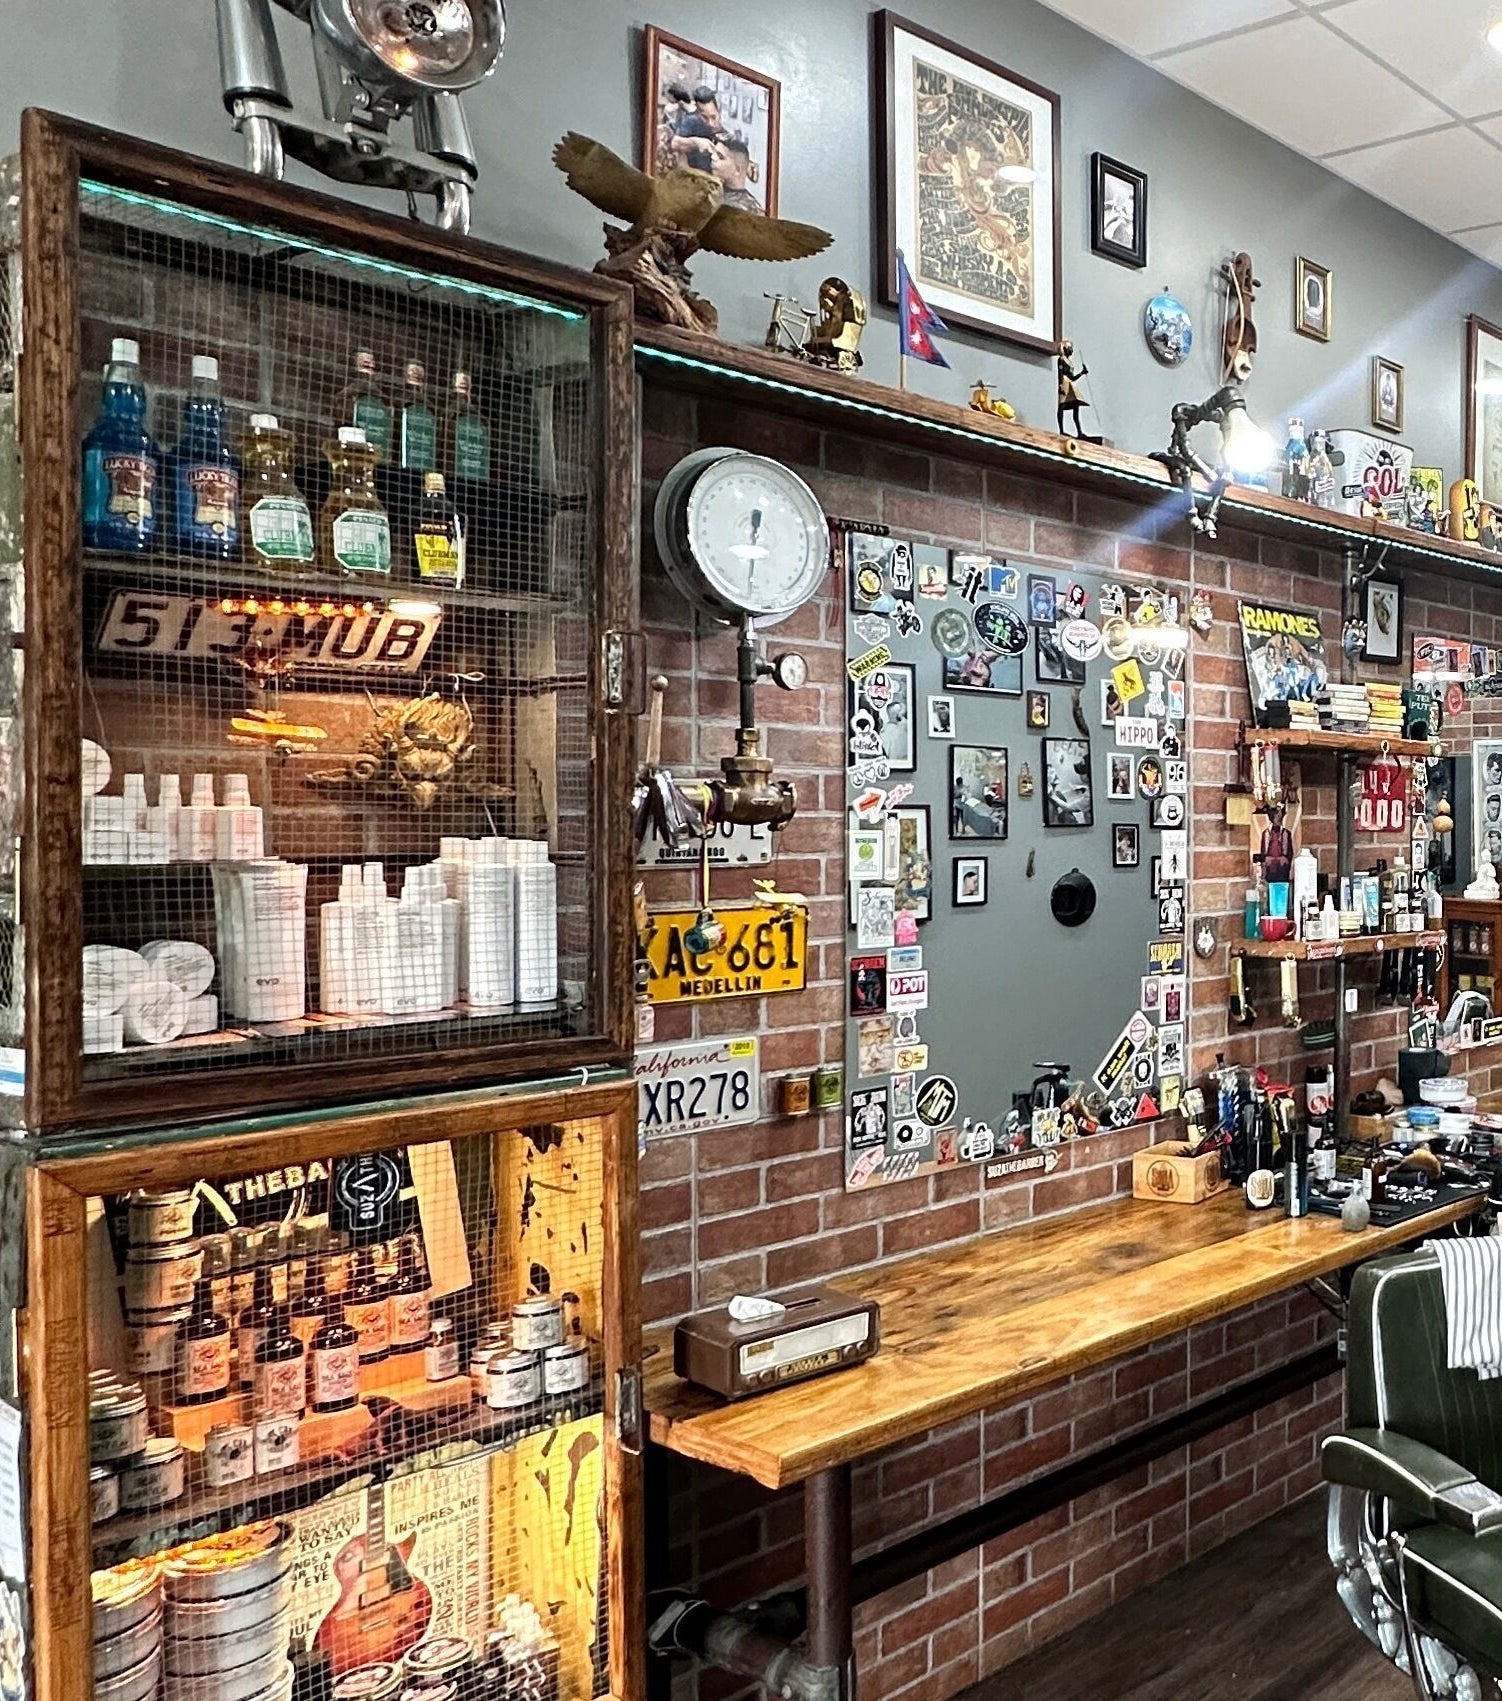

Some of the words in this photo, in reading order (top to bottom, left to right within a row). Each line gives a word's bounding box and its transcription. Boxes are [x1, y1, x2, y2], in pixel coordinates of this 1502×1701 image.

[917, 62, 948, 95] THE
[1243, 606, 1321, 639] RAMONES
[1120, 726, 1154, 745] HIPPO
[728, 921, 798, 973] 681
[256, 976, 280, 986] evo
[680, 980, 762, 997] MEDELLIN
[644, 1070, 750, 1126] XR278
[394, 1506, 454, 1535] INSPIRES
[460, 1496, 480, 1511] ME
[300, 1538, 319, 1552] TO
[325, 1528, 352, 1545] SAY
[293, 1554, 320, 1571] NGS
[323, 1551, 332, 1560] A
[313, 1563, 329, 1575] TO
[422, 1555, 455, 1577] THE
[304, 1571, 330, 1588] EYE
